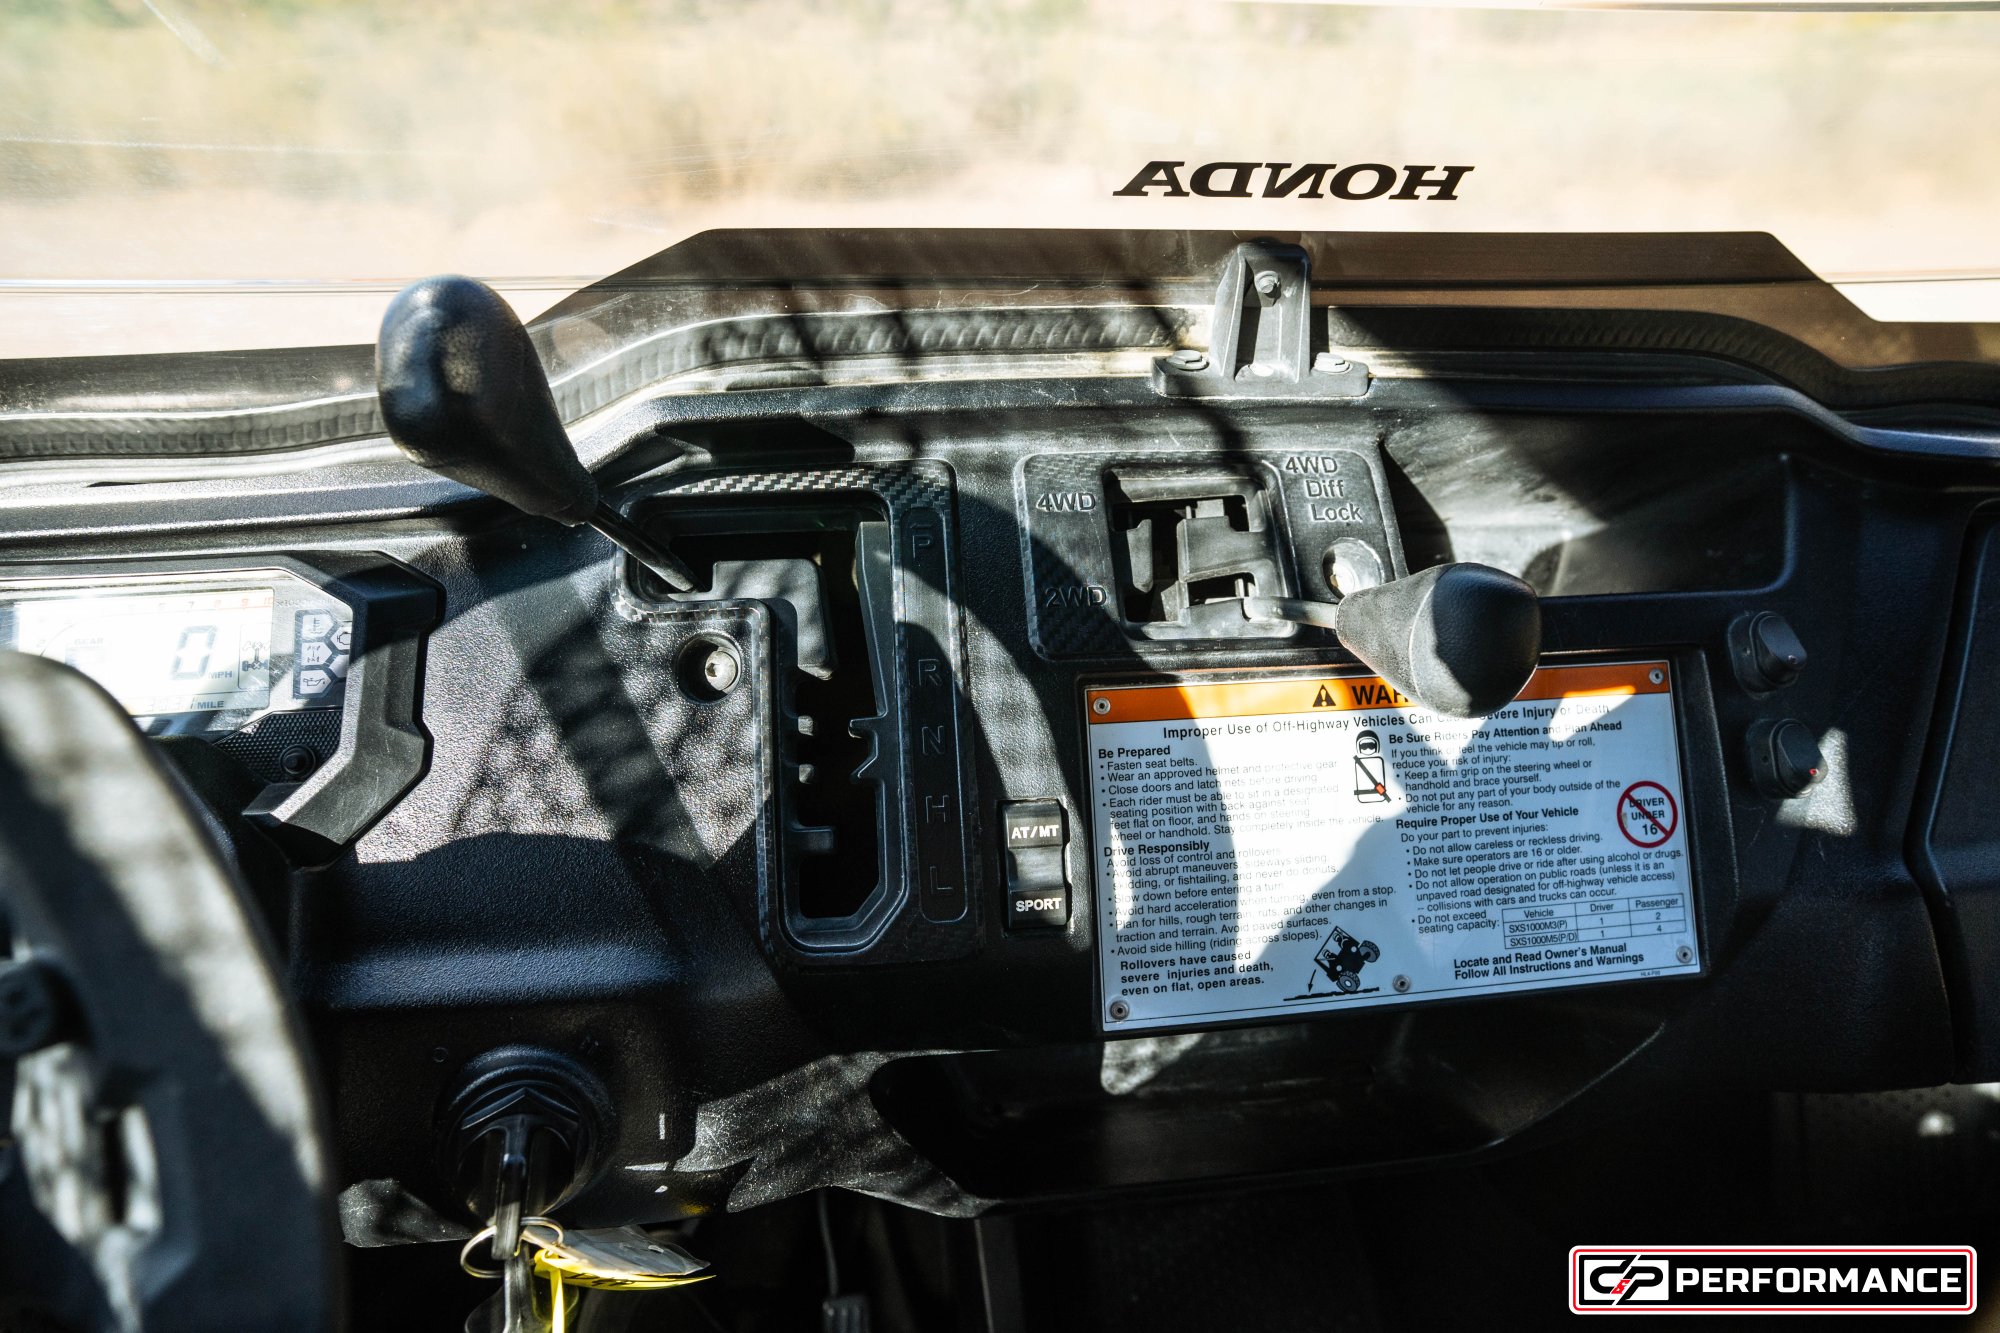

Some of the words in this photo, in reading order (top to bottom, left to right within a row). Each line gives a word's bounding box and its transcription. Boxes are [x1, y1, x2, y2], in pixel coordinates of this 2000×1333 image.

[1285, 456, 1338, 474] 4WD
[1305, 479, 1344, 498] Diff
[1036, 492, 1096, 513] 4WD
[1312, 503, 1363, 522] Lock
[912, 535, 935, 562] P
[1044, 585, 1107, 608] 2WD
[208, 670, 232, 680] MPH
[918, 659, 942, 687] R
[197, 700, 225, 709] MILE
[1163, 726, 1222, 741] Improper
[1227, 724, 1251, 735] Use
[1256, 722, 1267, 733] of
[1272, 720, 1349, 733] Off-Highway
[1353, 714, 1406, 727] Vehicles
[1408, 713, 1432, 724] Can
[1522, 705, 1556, 720] Injury
[1589, 720, 1622, 731] Ahead
[921, 726, 945, 755] N
[1388, 734, 1403, 744] Be
[1406, 732, 1431, 743] Sure
[1471, 729, 1490, 741] Pay
[1493, 726, 1540, 738] Attention
[1098, 748, 1114, 759] Be
[1117, 745, 1170, 759] Prepared
[1107, 761, 1142, 771] Fasten
[1145, 759, 1167, 769] seat
[1169, 757, 1197, 767] belts.
[1404, 771, 1429, 780] Keep
[1439, 767, 1460, 777] firm
[1459, 767, 1479, 779] grip
[1481, 767, 1494, 775] on
[1496, 765, 1511, 774] the
[1513, 762, 1551, 774] steering
[1553, 760, 1580, 770] wheel
[1582, 760, 1592, 768] or
[1107, 773, 1135, 782] Wear
[1137, 772, 1151, 780] an
[1153, 767, 1202, 781] approved
[1404, 779, 1450, 792] handhold
[1452, 778, 1471, 788] and
[1473, 777, 1500, 787] brace
[1502, 773, 1542, 787] yourself.
[1108, 785, 1138, 795] Close
[1141, 783, 1172, 793] doors
[1174, 780, 1194, 791] and
[926, 795, 950, 823] H
[1629, 797, 1665, 808] DRIVER
[1395, 817, 1438, 830] Require
[1440, 815, 1476, 827] Proper
[1479, 813, 1500, 823] Use
[1502, 811, 1513, 821] of
[1515, 810, 1539, 820] Your
[1541, 807, 1579, 818] Vehicle
[1631, 810, 1665, 820] UNDER
[1011, 825, 1059, 839] AT/MT
[1400, 833, 1415, 843] Do
[1417, 832, 1439, 843] your
[1441, 830, 1460, 841] part
[1462, 829, 1472, 838] to
[1474, 826, 1510, 839] prevent
[1512, 823, 1548, 836] injuries:
[1642, 823, 1658, 835] 16
[1138, 840, 1210, 858] Responsibly
[1412, 846, 1427, 855] Do
[1429, 844, 1445, 854] not
[1447, 842, 1472, 853] allow
[1474, 839, 1514, 851] careless
[1515, 839, 1526, 847] or
[1528, 835, 1567, 846] reckless
[1569, 832, 1603, 843] driving.
[1413, 856, 1440, 866] Make
[1442, 855, 1463, 865] sure
[1465, 851, 1511, 864] operators
[1513, 850, 1528, 859] are
[1531, 848, 1542, 857] 16
[1544, 848, 1554, 856] or
[1556, 845, 1582, 855] older.
[930, 866, 952, 895] L
[1415, 880, 1430, 890] Do
[1432, 878, 1448, 888] not
[1450, 877, 1475, 887] allow
[1477, 873, 1522, 887] operation
[1524, 872, 1537, 881] on
[1539, 869, 1568, 882] public
[1570, 866, 1596, 876] roads
[1599, 864, 1632, 876] (unless
[1634, 862, 1640, 871] it
[1642, 862, 1651, 871] is
[1652, 862, 1665, 870] an
[1416, 889, 1457, 902] unpaved
[1460, 887, 1481, 897] road
[1483, 882, 1535, 896] designated
[1537, 882, 1550, 891] for
[1552, 878, 1604, 890] off-highway
[1606, 874, 1638, 884] vehicle
[1640, 871, 1675, 882] access)
[1015, 898, 1062, 912] SPORT
[1523, 908, 1554, 919] Vehicle
[1589, 903, 1614, 912] Driver
[1635, 898, 1679, 912] Passenger
[1417, 915, 1432, 924] Do
[1434, 913, 1450, 923] not
[1452, 909, 1487, 921] exceed
[1115, 931, 1155, 942] traction
[1158, 928, 1179, 939] and
[1181, 925, 1217, 937] terrain.
[1418, 923, 1454, 934] seating
[1456, 919, 1500, 932] capacity:
[1117, 944, 1147, 956] Avoid
[1150, 942, 1172, 953] side
[1175, 940, 1206, 951] hilling
[1453, 956, 1489, 969] Locate
[1492, 953, 1512, 965] and
[1514, 951, 1542, 963] Read
[1544, 947, 1587, 960] Owner's
[1589, 943, 1627, 955] Manual
[1120, 958, 1176, 971] Rollovers
[1179, 956, 1207, 966] have
[1210, 950, 1251, 963] caused
[1454, 968, 1490, 980] Follow
[1492, 965, 1507, 976] All
[1509, 961, 1571, 975] Instructions
[1573, 957, 1593, 968] and
[1595, 953, 1644, 966] Warnings
[1120, 973, 1160, 983] severe
[1167, 967, 1210, 981] injuries
[1213, 964, 1236, 975] and
[1238, 961, 1273, 973] death,
[1121, 986, 1149, 996] even
[1153, 985, 1167, 994] on
[1171, 981, 1193, 992] flat,
[1197, 979, 1226, 991] open
[1229, 976, 1264, 987] areas.
